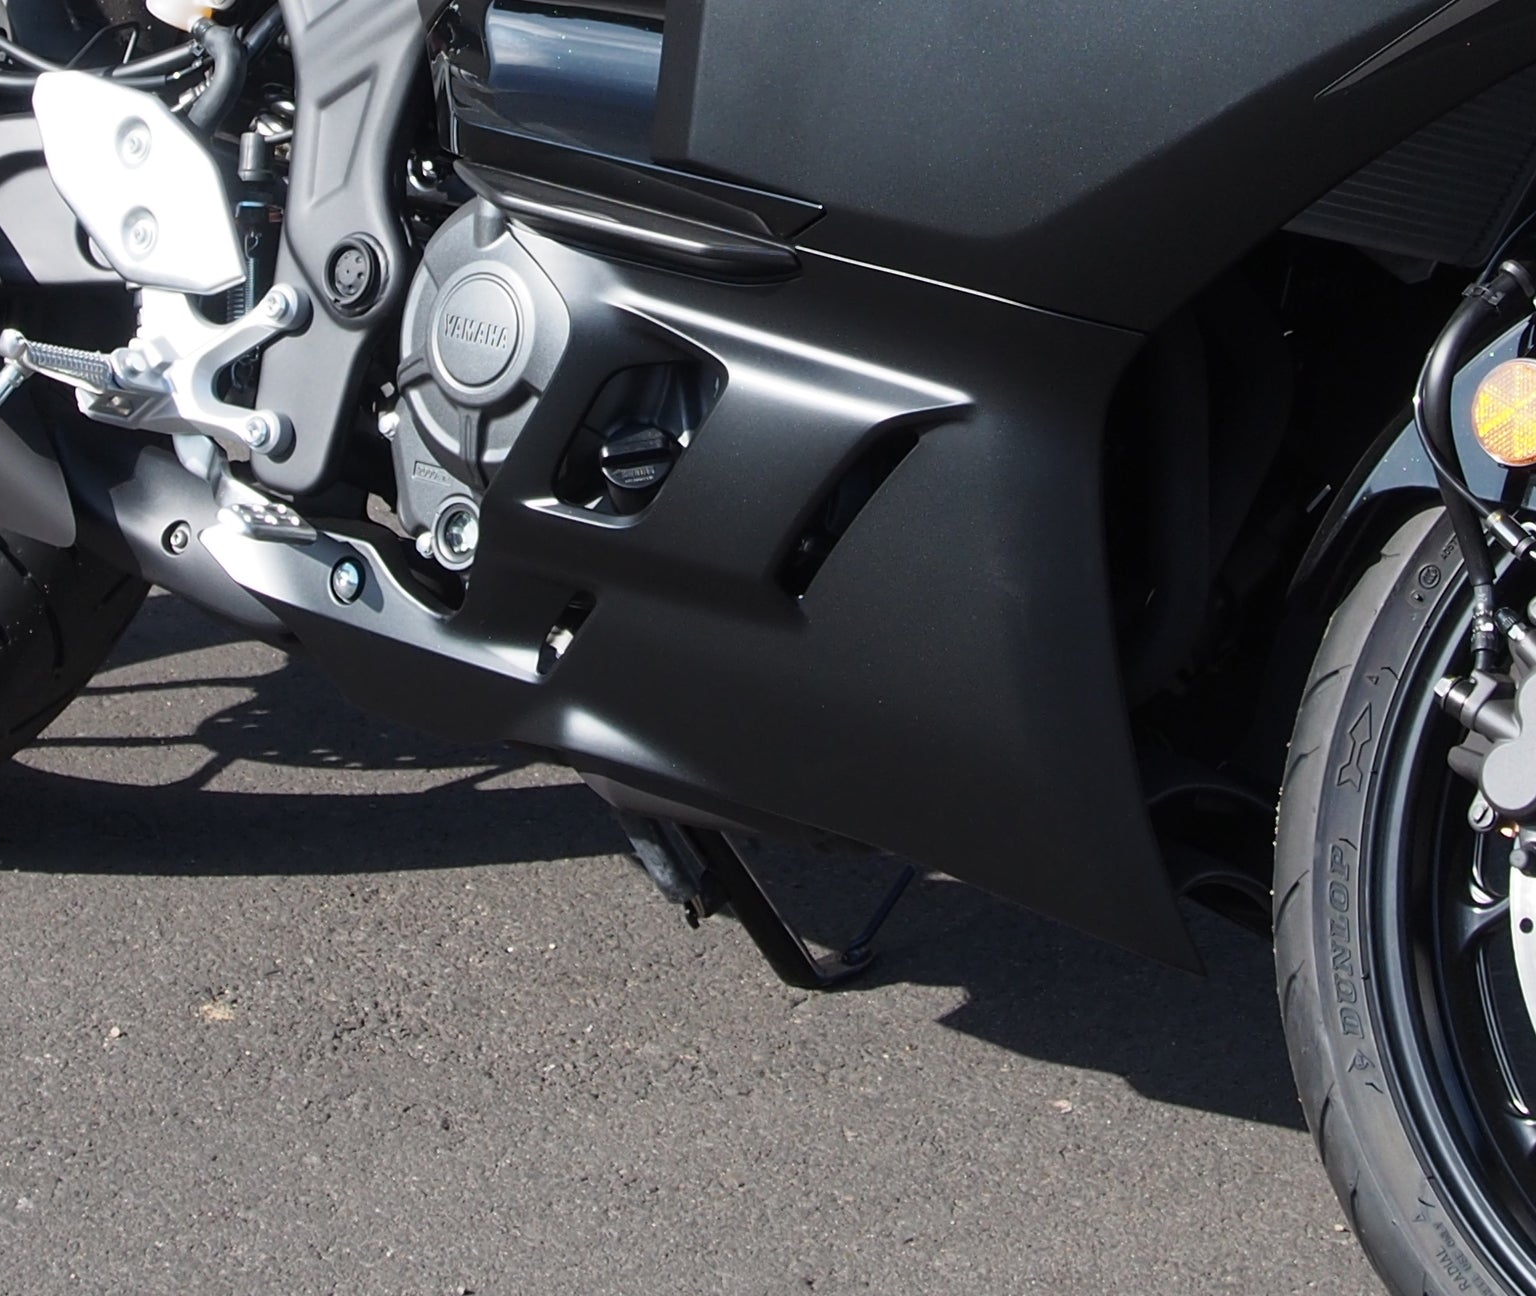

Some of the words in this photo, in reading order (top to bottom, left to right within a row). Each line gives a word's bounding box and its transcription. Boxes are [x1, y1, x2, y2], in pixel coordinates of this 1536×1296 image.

[445, 313, 510, 351] YAMAHA
[1329, 843, 1365, 1040] DUNLOP
[1435, 1245, 1471, 1292] RADIAL
